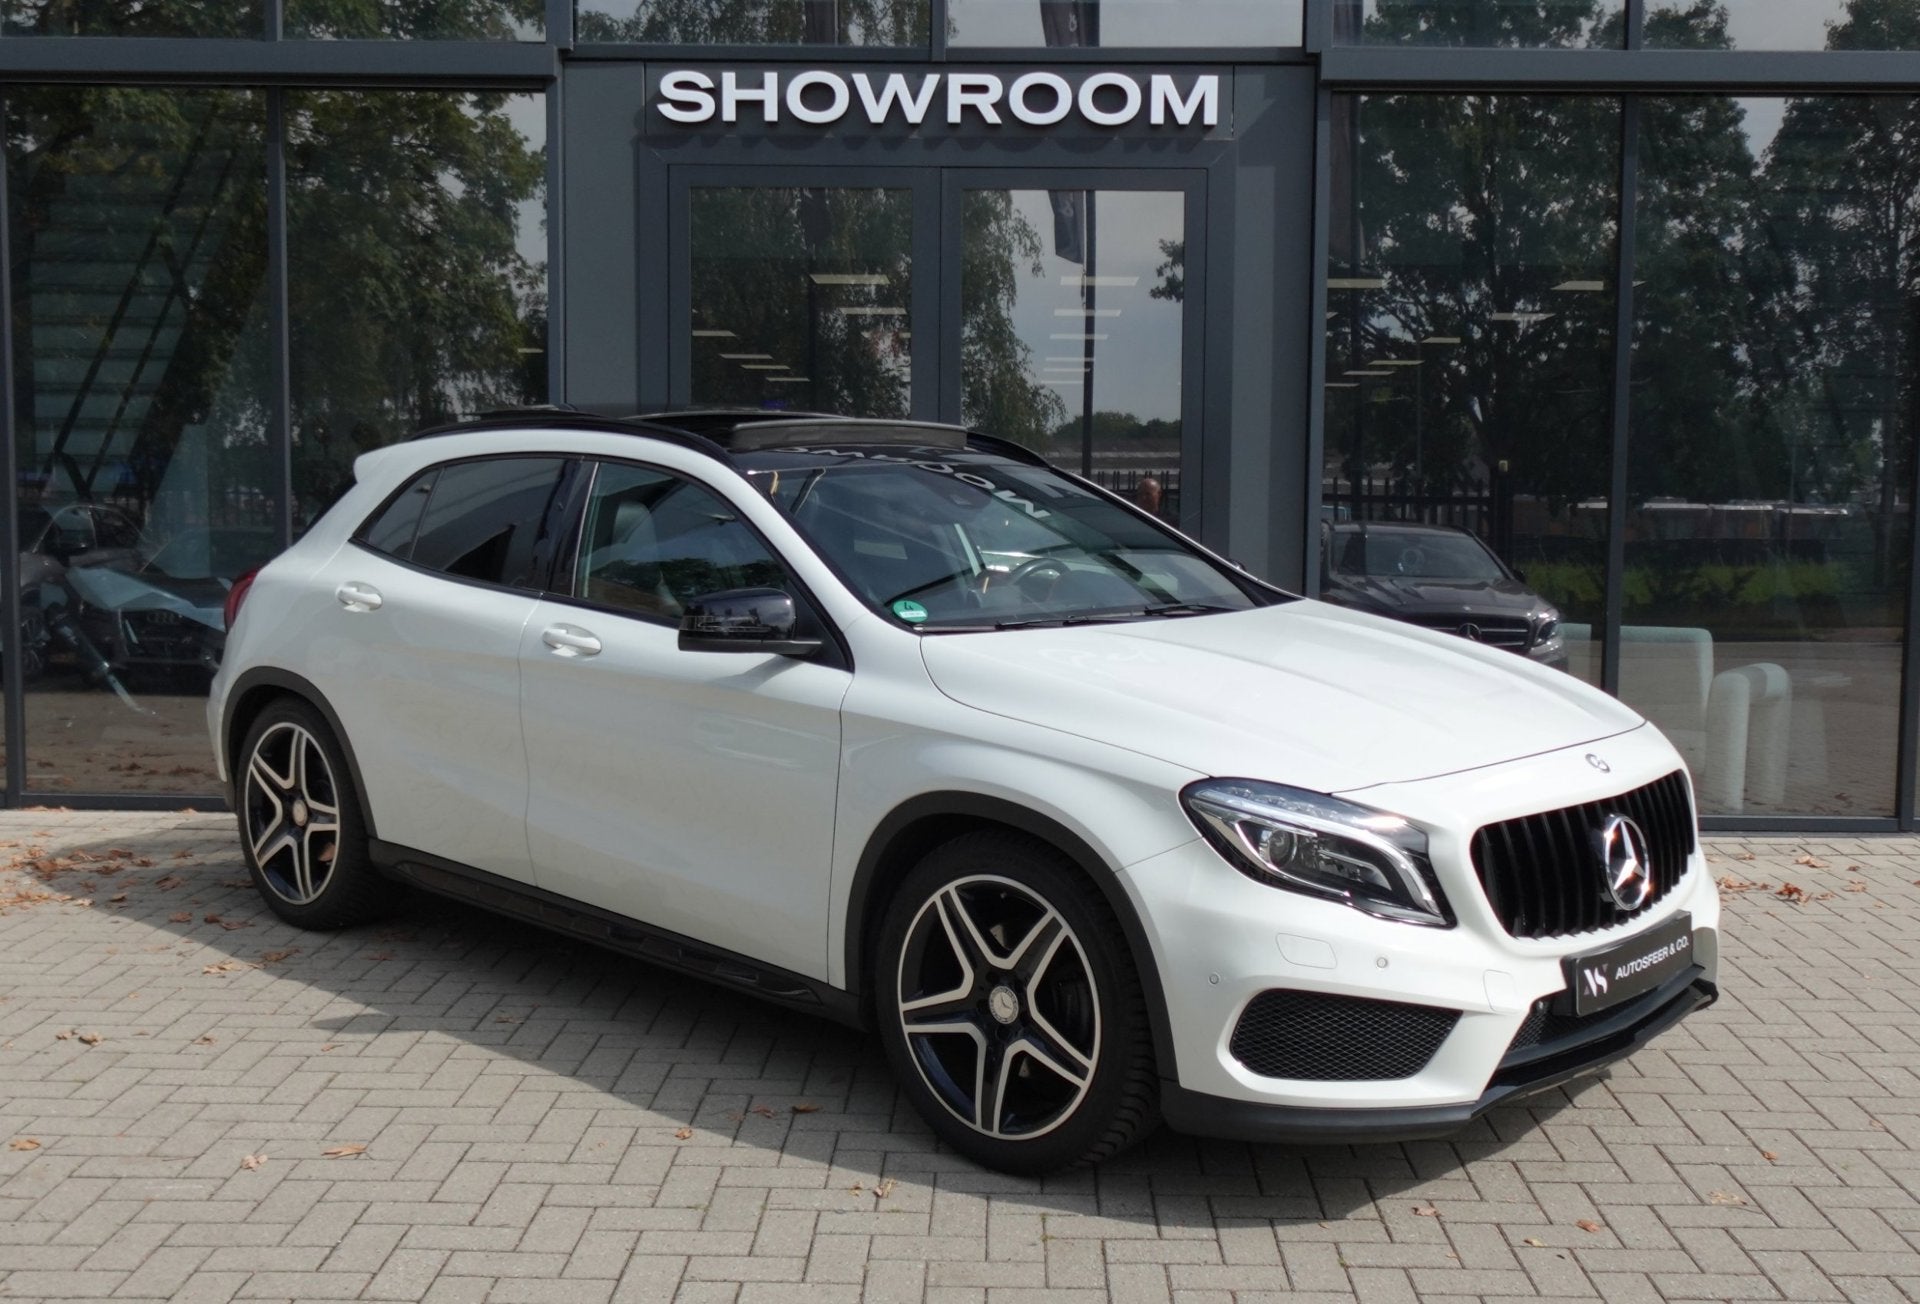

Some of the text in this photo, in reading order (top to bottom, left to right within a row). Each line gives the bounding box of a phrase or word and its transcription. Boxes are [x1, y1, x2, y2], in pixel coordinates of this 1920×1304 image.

[657, 70, 1219, 126] SHOWROOM
[1615, 935, 1689, 980] AUTOSFEER & CO.
